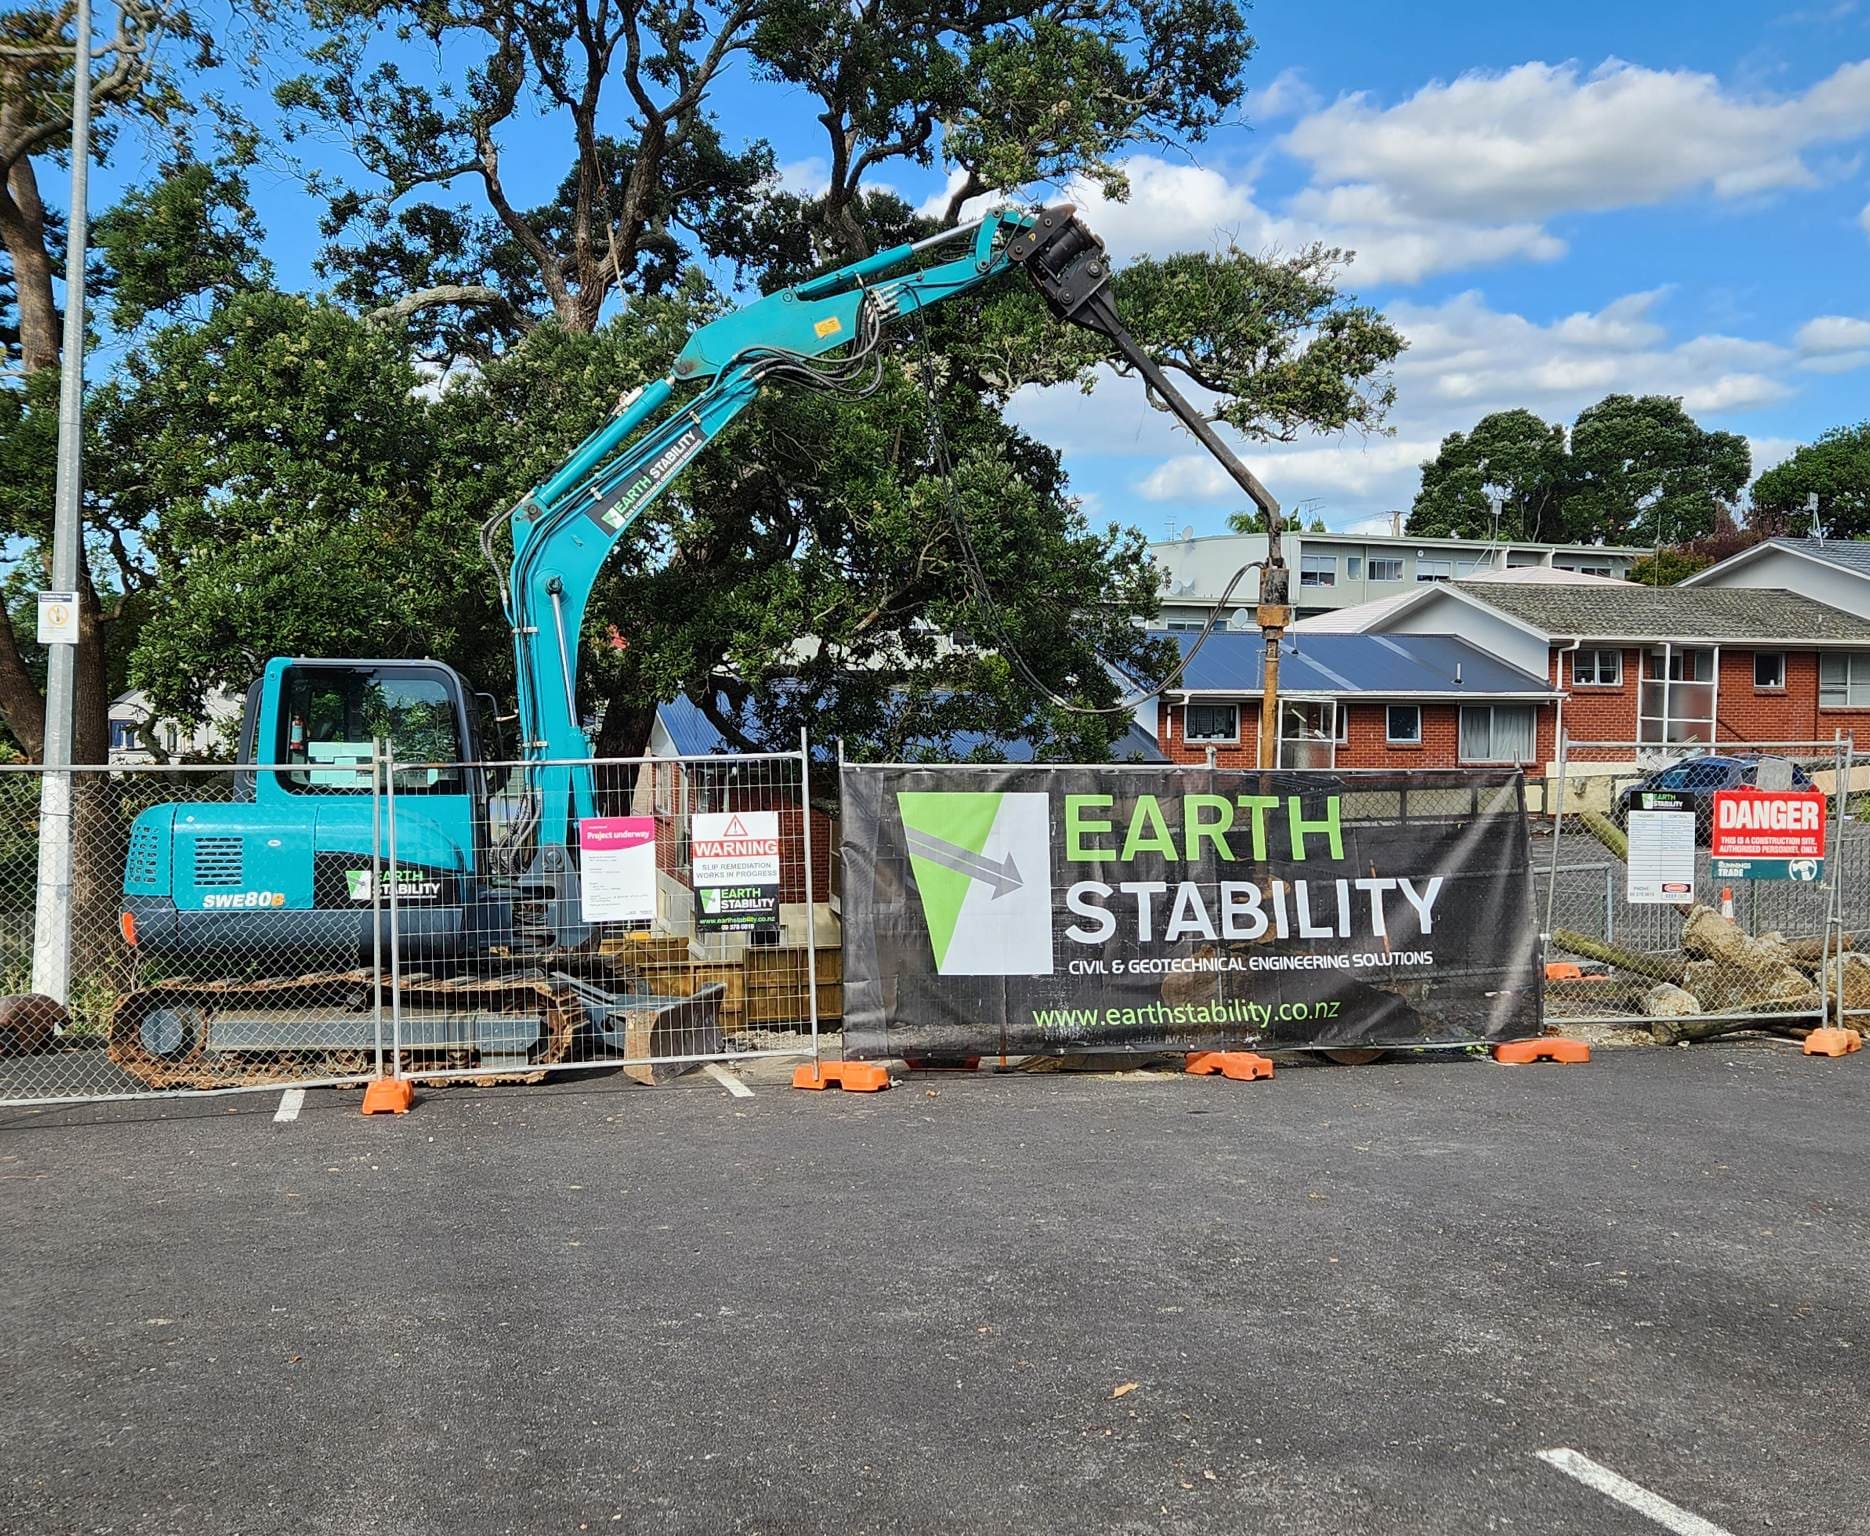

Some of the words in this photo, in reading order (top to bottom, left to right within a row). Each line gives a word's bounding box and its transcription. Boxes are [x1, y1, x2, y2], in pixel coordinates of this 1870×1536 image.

[613, 475, 652, 513] EARTH
[649, 430, 696, 478] STABILITY
[1719, 800, 1819, 830] DANGER
[586, 831, 613, 840] Project
[613, 830, 650, 839] underway
[1065, 794, 1345, 862] EARTH
[694, 840, 778, 856] WARNING
[1721, 836, 1736, 844] THIS
[1737, 836, 1744, 844] IS
[1751, 837, 1800, 845] CONSTRUCTION
[1719, 845, 1761, 853] AUTHORISED
[720, 862, 771, 870] REMEDIATION
[1718, 869, 1744, 877] TRADE
[202, 891, 285, 908] SWE80B
[721, 888, 761, 899] EARTH
[721, 898, 775, 909] STABILITY
[1065, 876, 1445, 944] STABILITY
[1069, 959, 1108, 975] CIVIL
[1112, 959, 1125, 974] &
[1128, 957, 1247, 974] GEOTECHNICAL
[1249, 954, 1350, 970] ENGINEERING
[1353, 951, 1433, 968] SOLUTIONS
[1032, 999, 1342, 1028] www.earthstability.co.nz
